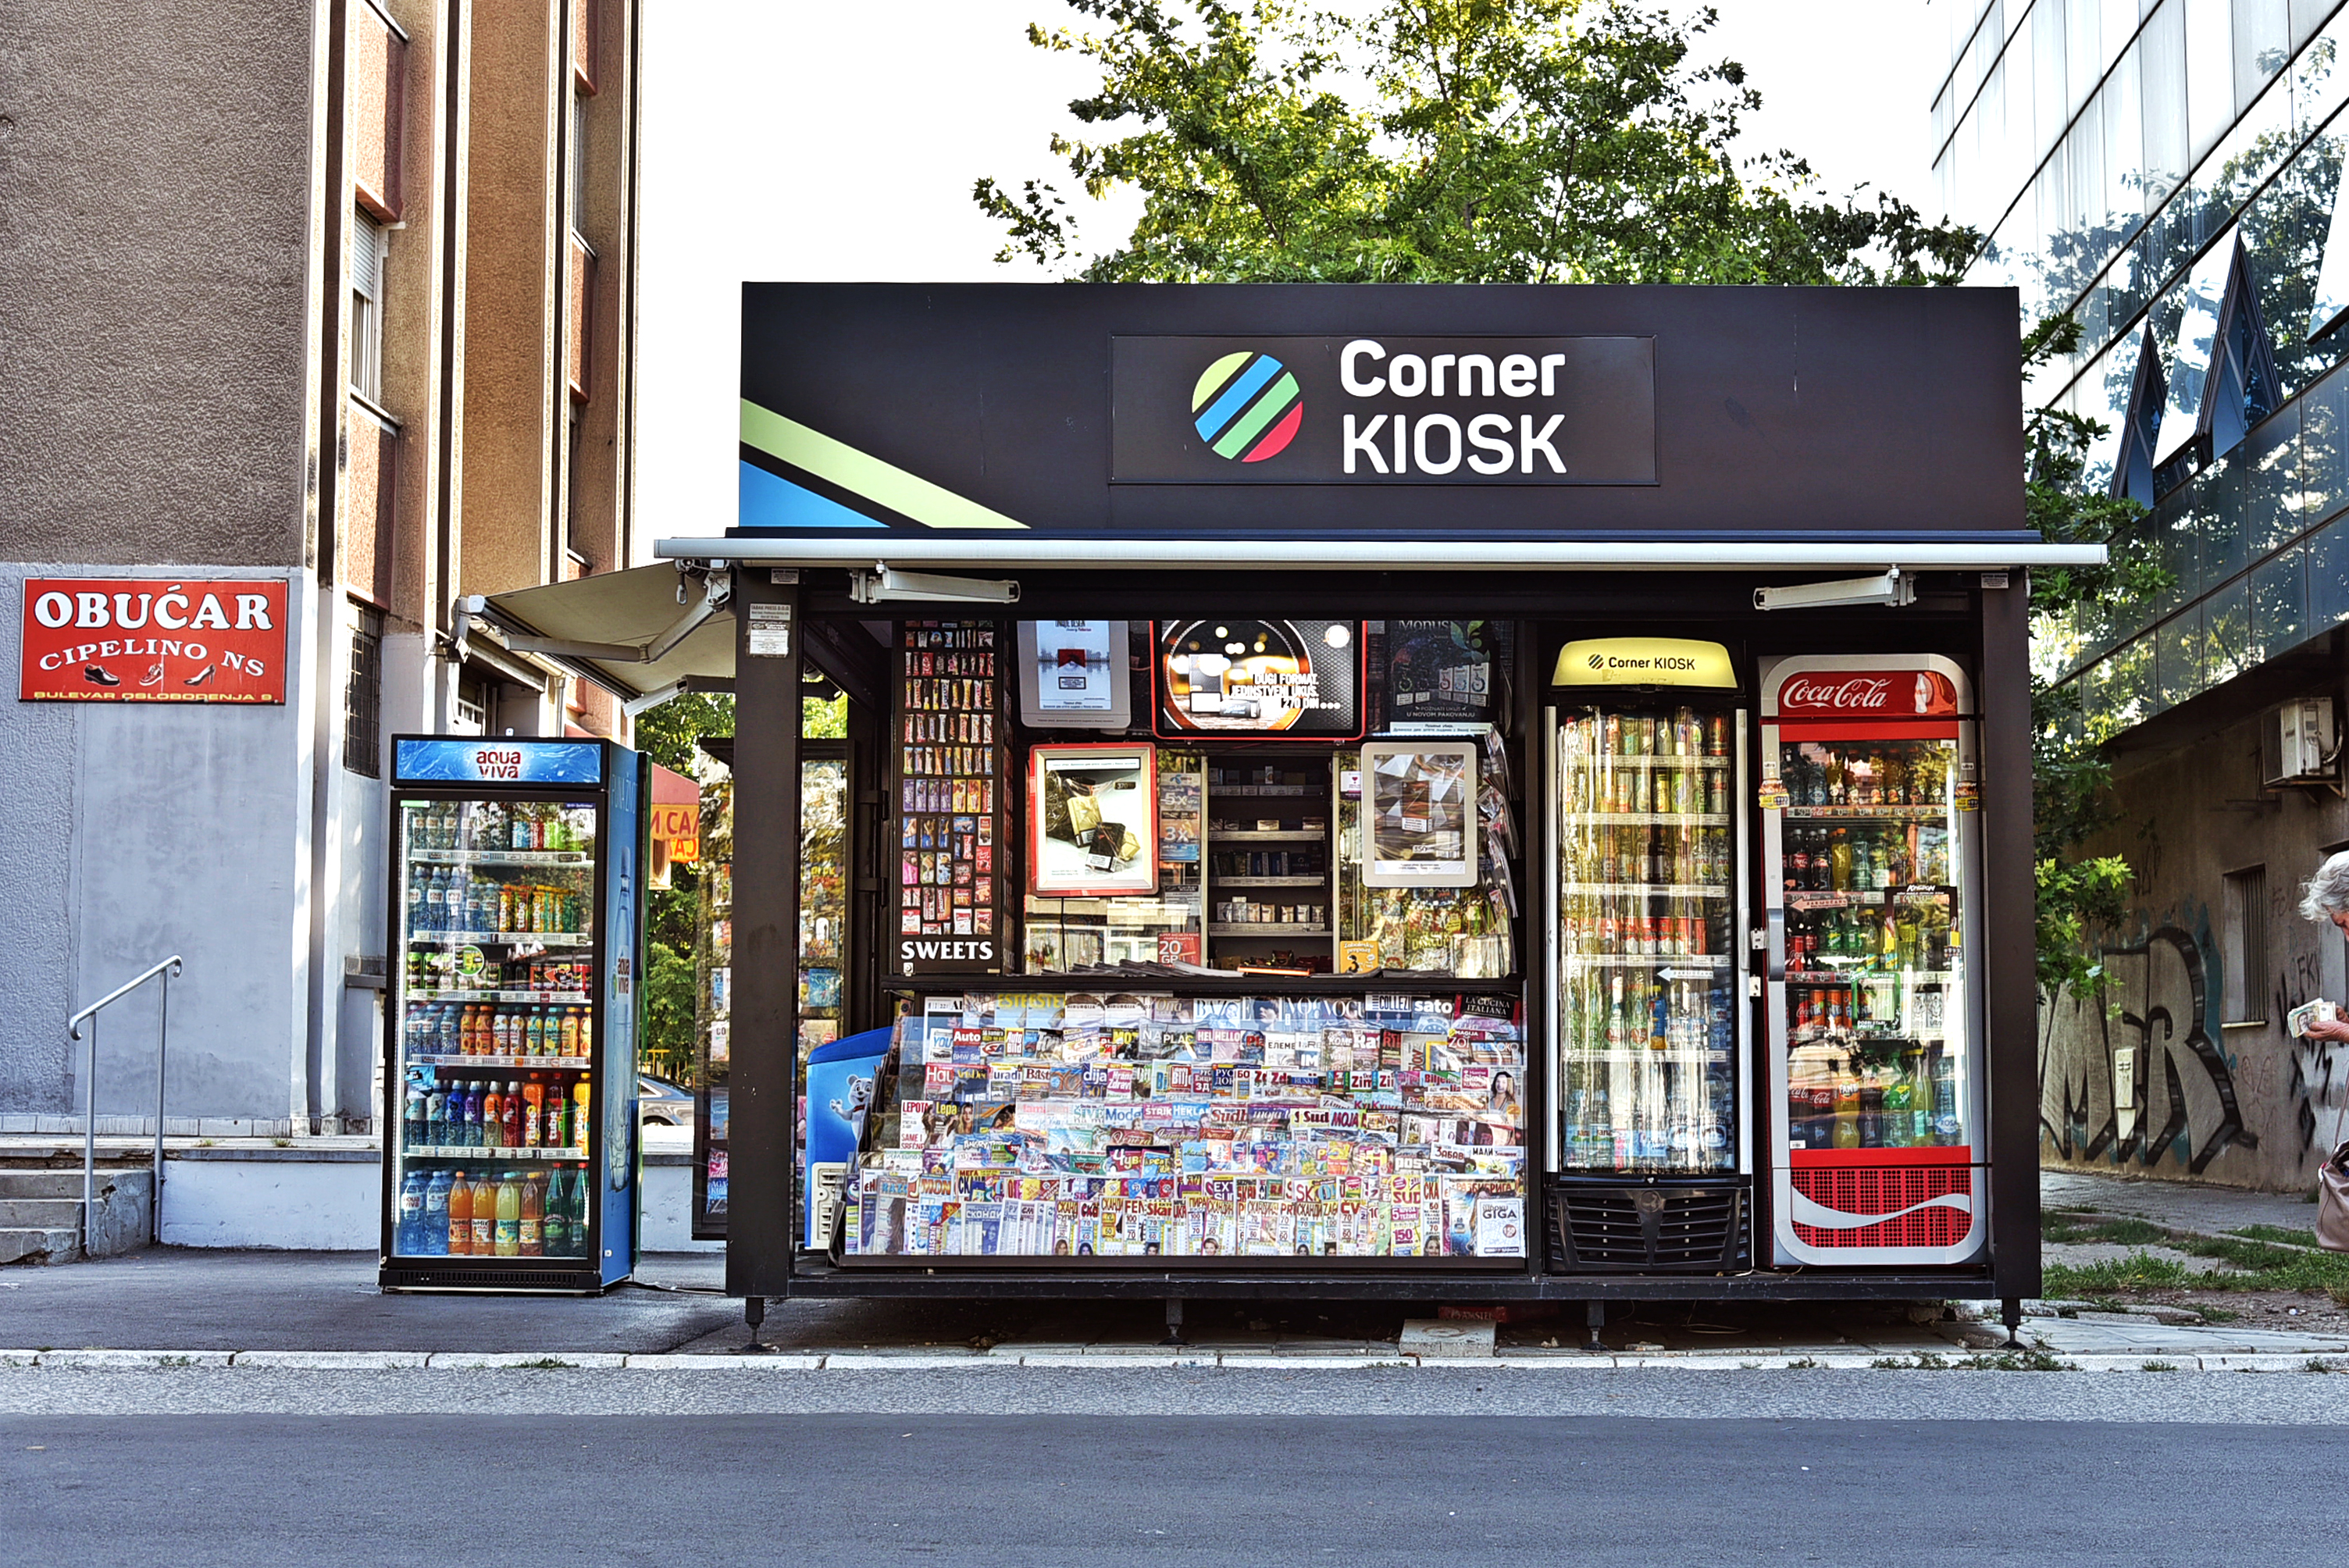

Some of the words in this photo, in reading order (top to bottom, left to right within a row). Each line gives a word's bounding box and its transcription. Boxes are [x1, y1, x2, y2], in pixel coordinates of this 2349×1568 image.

[1339, 339, 1566, 398] Corner
[1342, 413, 1567, 476] KIOSK
[34, 584, 273, 630] OBUĆAR
[39, 639, 208, 672] CIPELINO
[220, 650, 265, 676] NS
[1608, 657, 1651, 668] Corner
[1654, 657, 1695, 670] KIOSK
[1254, 673, 1277, 685] DUGI
[1279, 673, 1319, 685] FORMAT.
[34, 691, 116, 700] BULEVAR
[1230, 685, 1289, 697] JEDINSTVENI
[1292, 685, 1319, 697] UKUS.
[1783, 678, 1893, 708] Coca-Cola
[476, 750, 521, 765] aqua
[478, 764, 519, 779] viva
[901, 941, 993, 960] SWEETS
[1159, 940, 1182, 955] 20
[1414, 1000, 1453, 1014] sato
[1467, 1004, 1507, 1015] ITALIANA
[1477, 997, 1510, 1009] CUCINA
[954, 1032, 981, 1042] Auto
[1214, 1031, 1240, 1042] HELLO
[936, 1103, 957, 1115] Lepa
[527, 1111, 536, 1140] tube
[1331, 1112, 1359, 1128] MOJA
[1483, 1210, 1517, 1219] GIGA
[1394, 1228, 1413, 1241] 150
